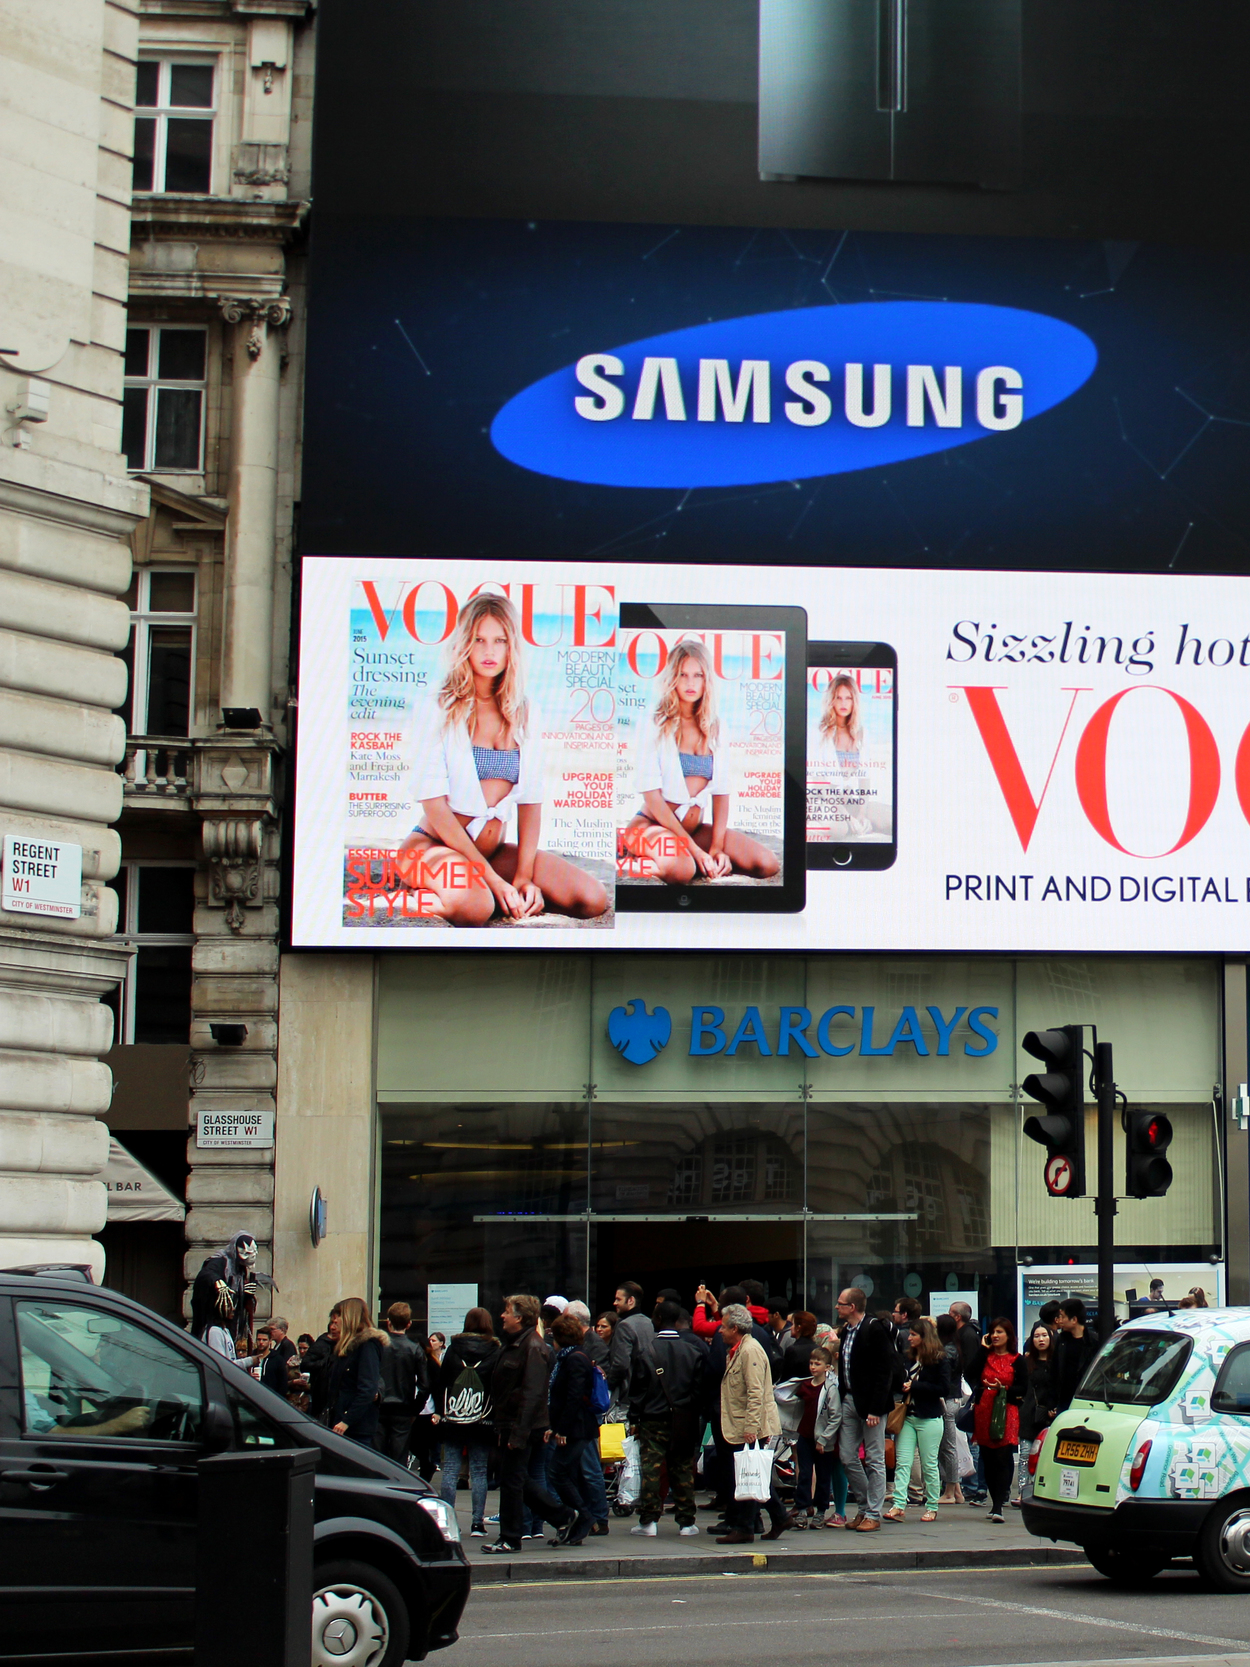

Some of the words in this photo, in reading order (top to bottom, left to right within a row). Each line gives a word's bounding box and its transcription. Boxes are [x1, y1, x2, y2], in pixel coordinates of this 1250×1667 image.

[574, 353, 1024, 431] SAMSUNG
[946, 621, 1157, 675] Sizzling
[353, 648, 415, 665] Sunset
[558, 651, 616, 664] MODERN
[565, 664, 615, 675] BEAUTY
[353, 666, 427, 686] dressing
[566, 676, 615, 688] SPECIAL
[353, 685, 377, 696] The
[351, 697, 405, 709] evening
[570, 689, 616, 723] 20
[351, 708, 376, 720] edit
[575, 723, 600, 732] PAGES
[750, 710, 783, 736] 20
[351, 732, 380, 741] ROCK
[384, 733, 402, 741] THE
[541, 732, 592, 740] INNOVATION
[351, 741, 394, 750] KASBAH
[563, 741, 614, 750] INSPIRATION
[351, 751, 373, 761] Kate
[375, 751, 401, 761] Moss
[350, 762, 368, 771] and
[350, 772, 401, 781] Marrakesh
[562, 773, 614, 782] UPGRADE
[744, 771, 781, 779] UPGRADE
[584, 782, 613, 791] YOUR
[349, 793, 388, 801] BUTTER
[567, 791, 613, 800] HOLIDAY
[349, 802, 365, 810] THE
[366, 802, 411, 810] SURPRISING
[553, 799, 613, 809] WARDROBE
[820, 798, 845, 806] MOSS
[552, 818, 573, 828] The
[575, 819, 613, 828] Muslim
[573, 829, 613, 838] feminist
[547, 840, 579, 851] taking
[595, 840, 613, 849] the
[13, 842, 60, 861] REGENT
[13, 860, 57, 878] STREET
[347, 861, 486, 890] SUMMER
[12, 877, 30, 893] W1
[945, 875, 1034, 901] PRINT
[1041, 876, 1116, 902] AND
[1119, 877, 1238, 904] DIGITAL
[35, 903, 73, 914] WESTMINSTER
[347, 890, 435, 917] STYLE
[688, 1005, 1000, 1059] BARCLAYS
[204, 1115, 262, 1124] GLASSHOUSE
[203, 1126, 239, 1135] STREET
[244, 1126, 257, 1135] W1
[116, 1182, 142, 1191] BAR
[1060, 1442, 1079, 1457] LR56
[1080, 1444, 1096, 1459] ZHH
[1163, 1445, 1173, 1471] Grosvenor
[1063, 1479, 1074, 1487] 79741
